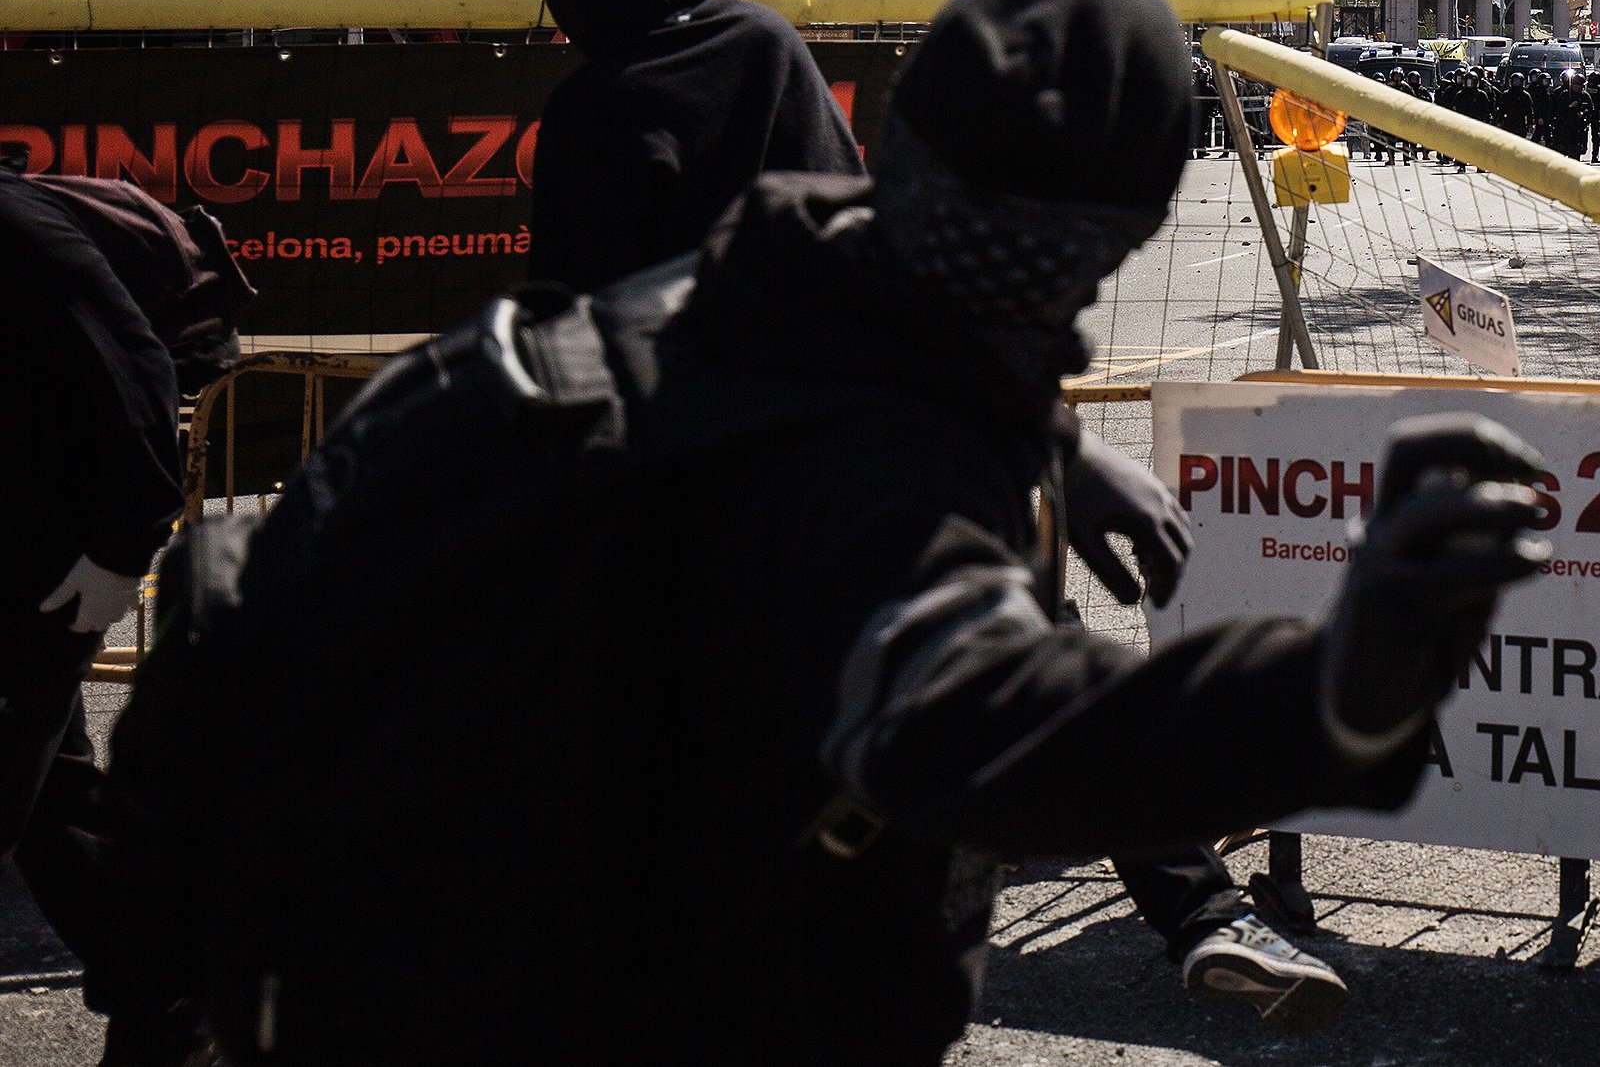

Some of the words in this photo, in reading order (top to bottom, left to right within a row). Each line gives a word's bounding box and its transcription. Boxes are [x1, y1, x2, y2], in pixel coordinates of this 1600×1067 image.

[0, 116, 540, 205] PINCHAZ
[226, 231, 363, 264] celona,
[377, 226, 532, 265] pneumà
[1457, 303, 1506, 338] GRUAS
[1179, 454, 1561, 531] PINCHS
